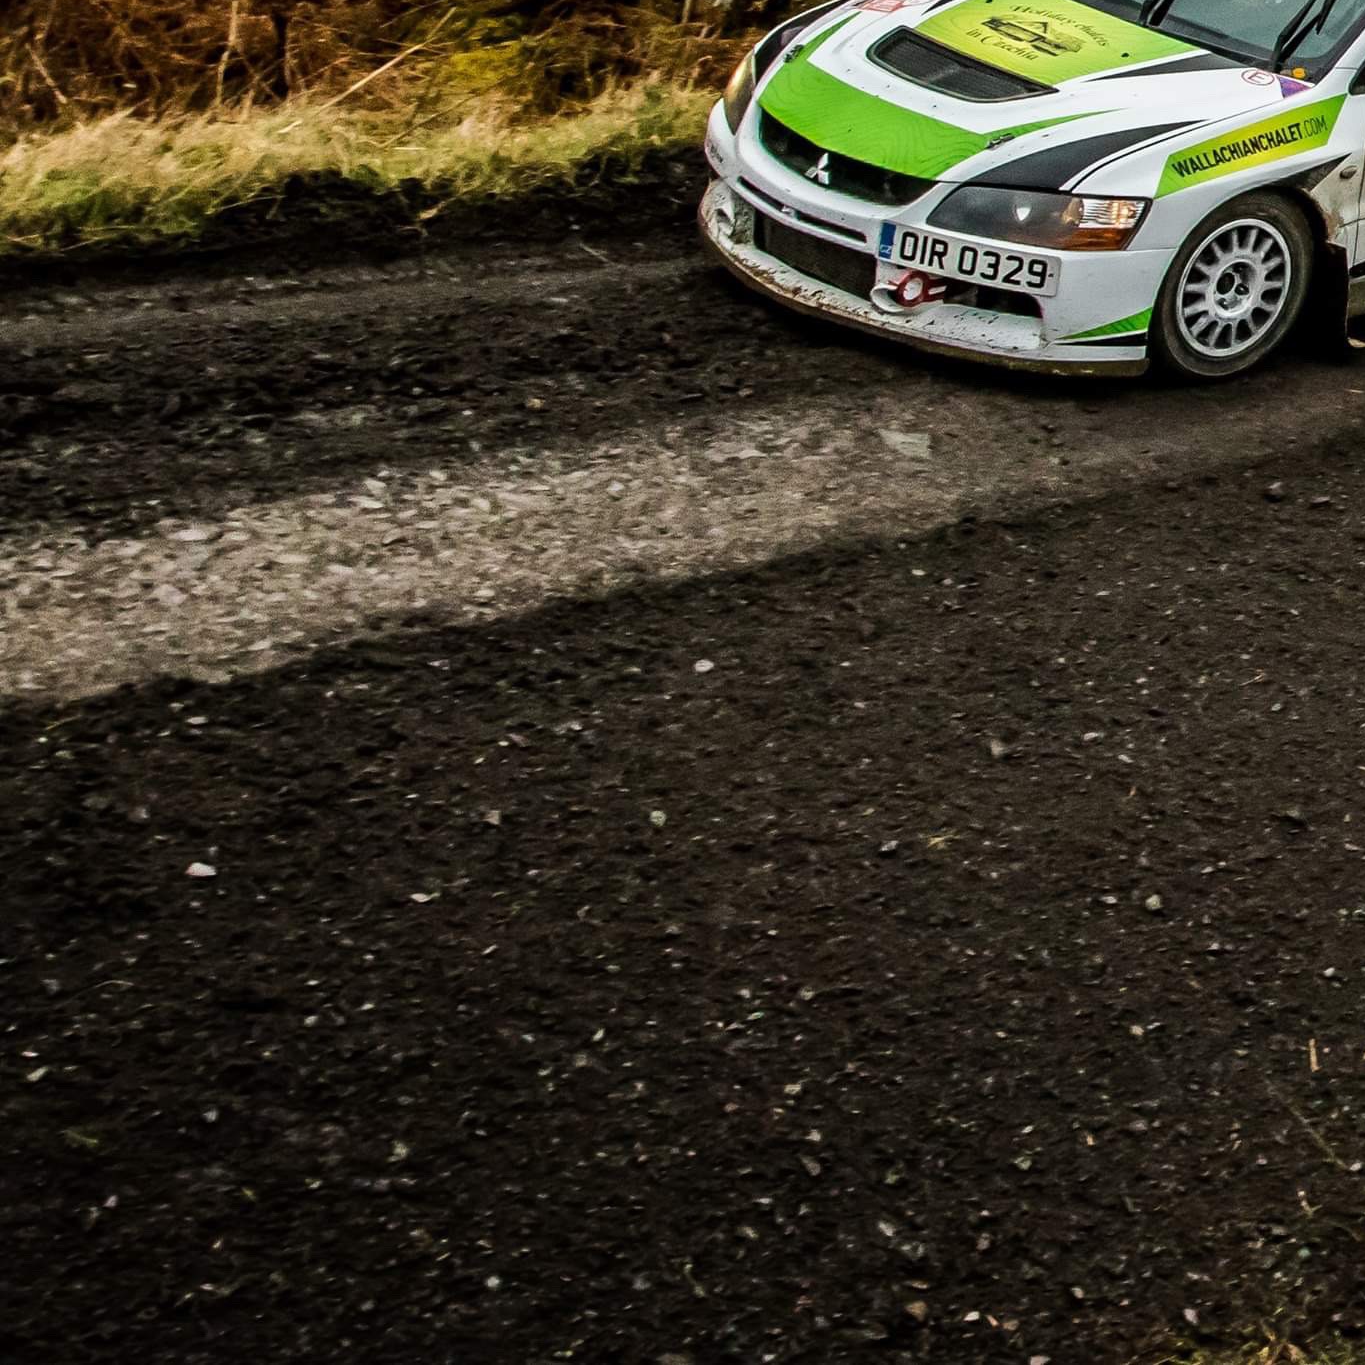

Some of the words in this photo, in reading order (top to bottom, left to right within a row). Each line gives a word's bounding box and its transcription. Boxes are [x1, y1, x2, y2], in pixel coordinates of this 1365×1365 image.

[1009, 3, 1076, 26] Holiday
[1171, 114, 1328, 178] WALLACHIANCHALET.COM
[957, 244, 1049, 290] 0329
